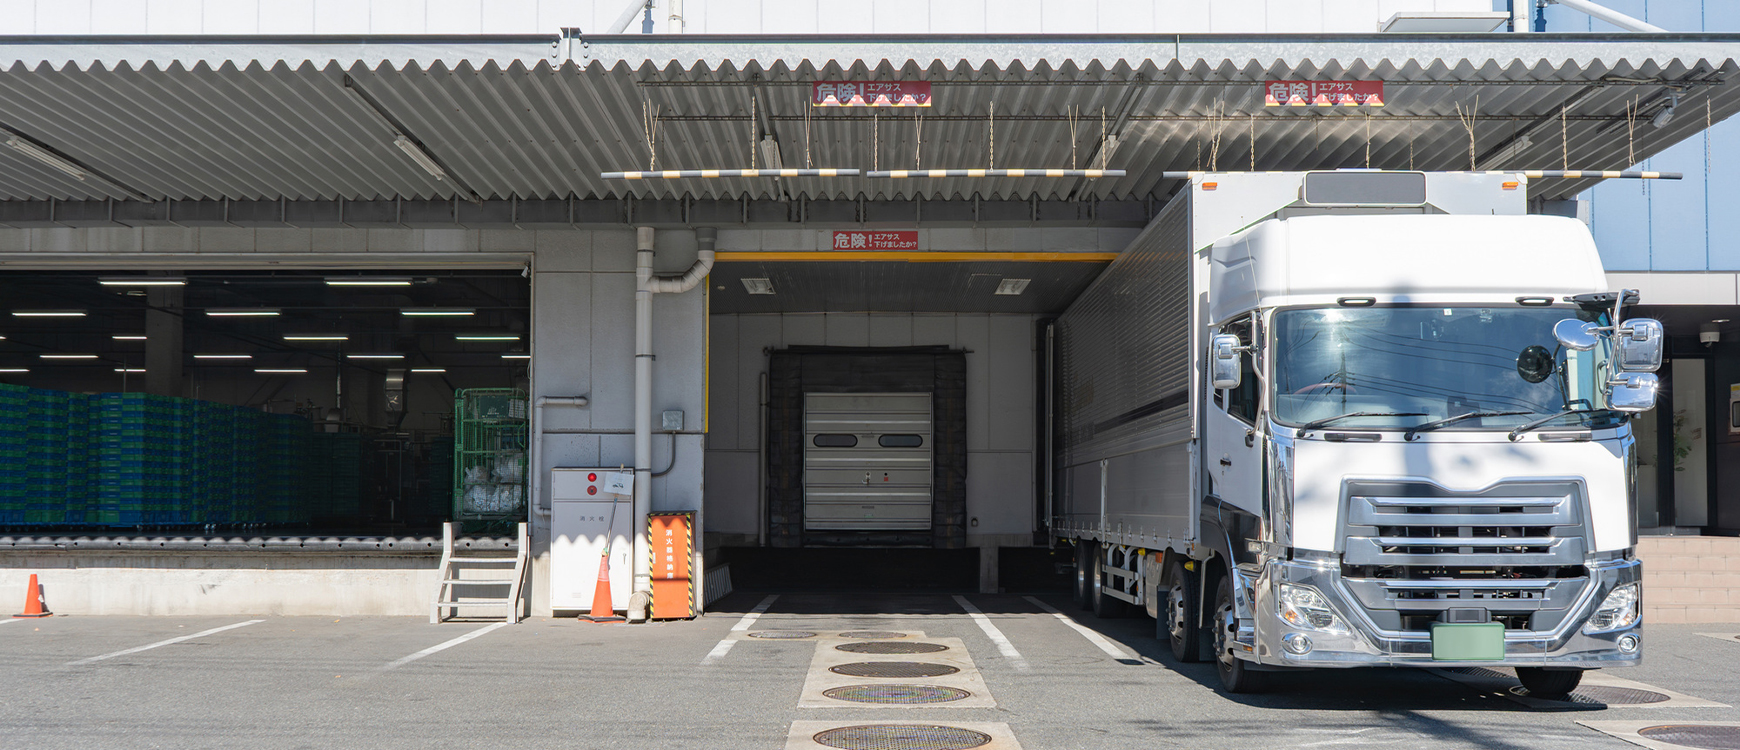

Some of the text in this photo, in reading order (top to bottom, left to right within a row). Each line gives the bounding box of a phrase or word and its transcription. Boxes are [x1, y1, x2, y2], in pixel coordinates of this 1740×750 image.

[816, 83, 864, 102] 危険!
[867, 84, 901, 92] エアサス
[1269, 82, 1317, 102] 危険!
[1320, 83, 1353, 91] エアサス
[834, 232, 873, 248] 危険!
